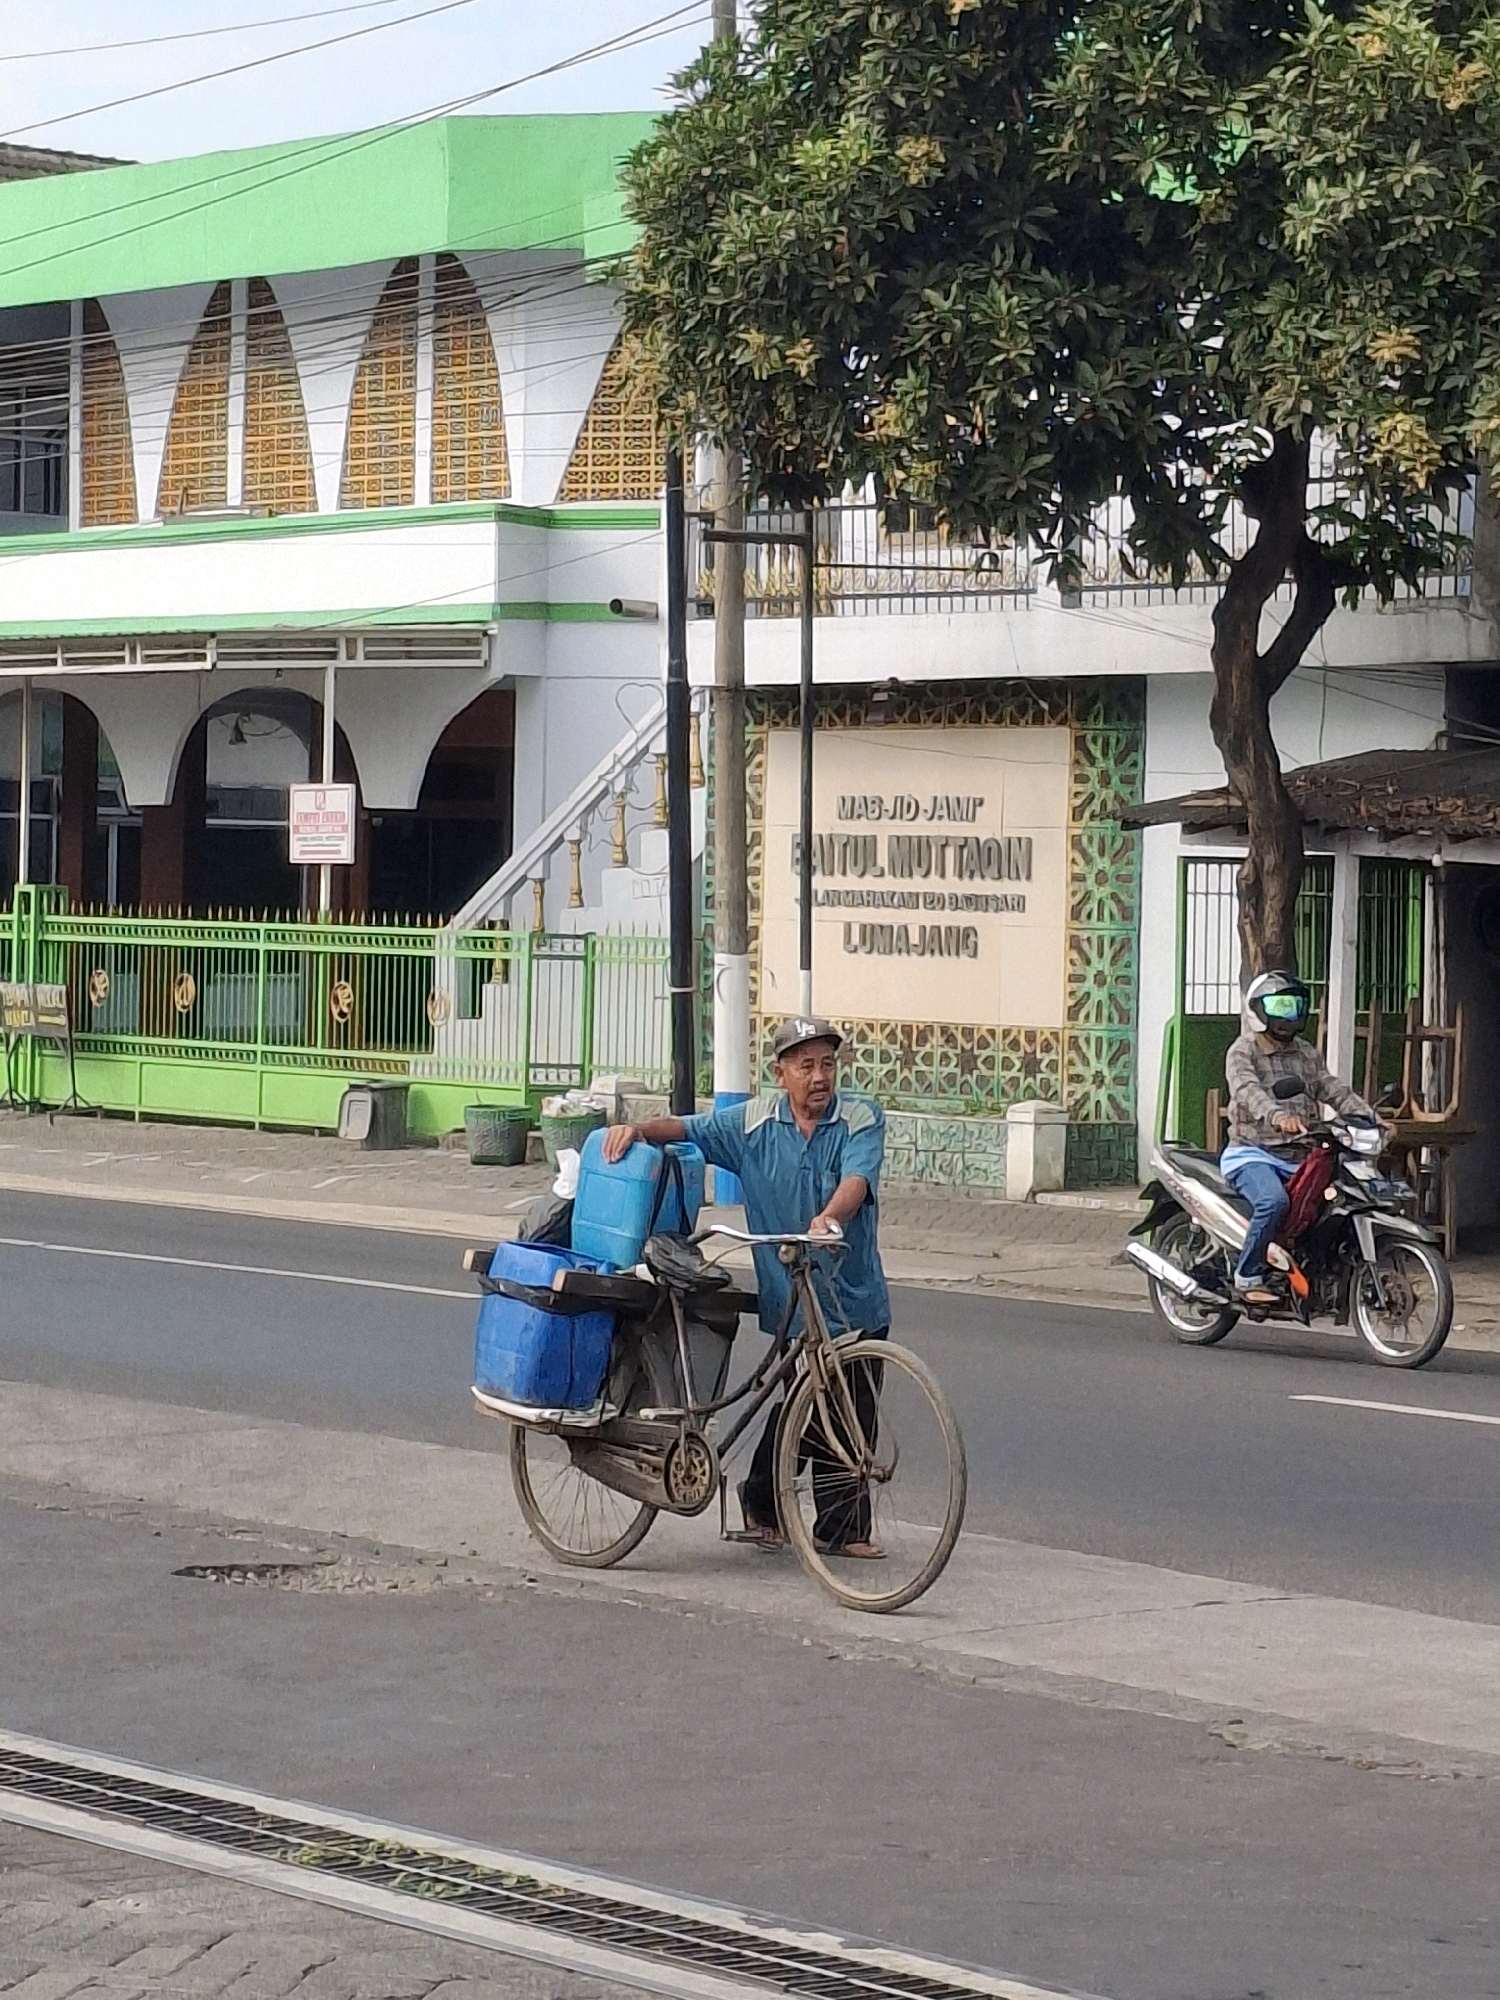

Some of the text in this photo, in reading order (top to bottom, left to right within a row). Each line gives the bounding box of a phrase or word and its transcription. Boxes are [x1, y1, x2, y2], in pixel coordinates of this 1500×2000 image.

[837, 794, 920, 822] MASJID
[887, 834, 1033, 882] MUTTAQIN
[842, 922, 978, 960] LUMAJANG
